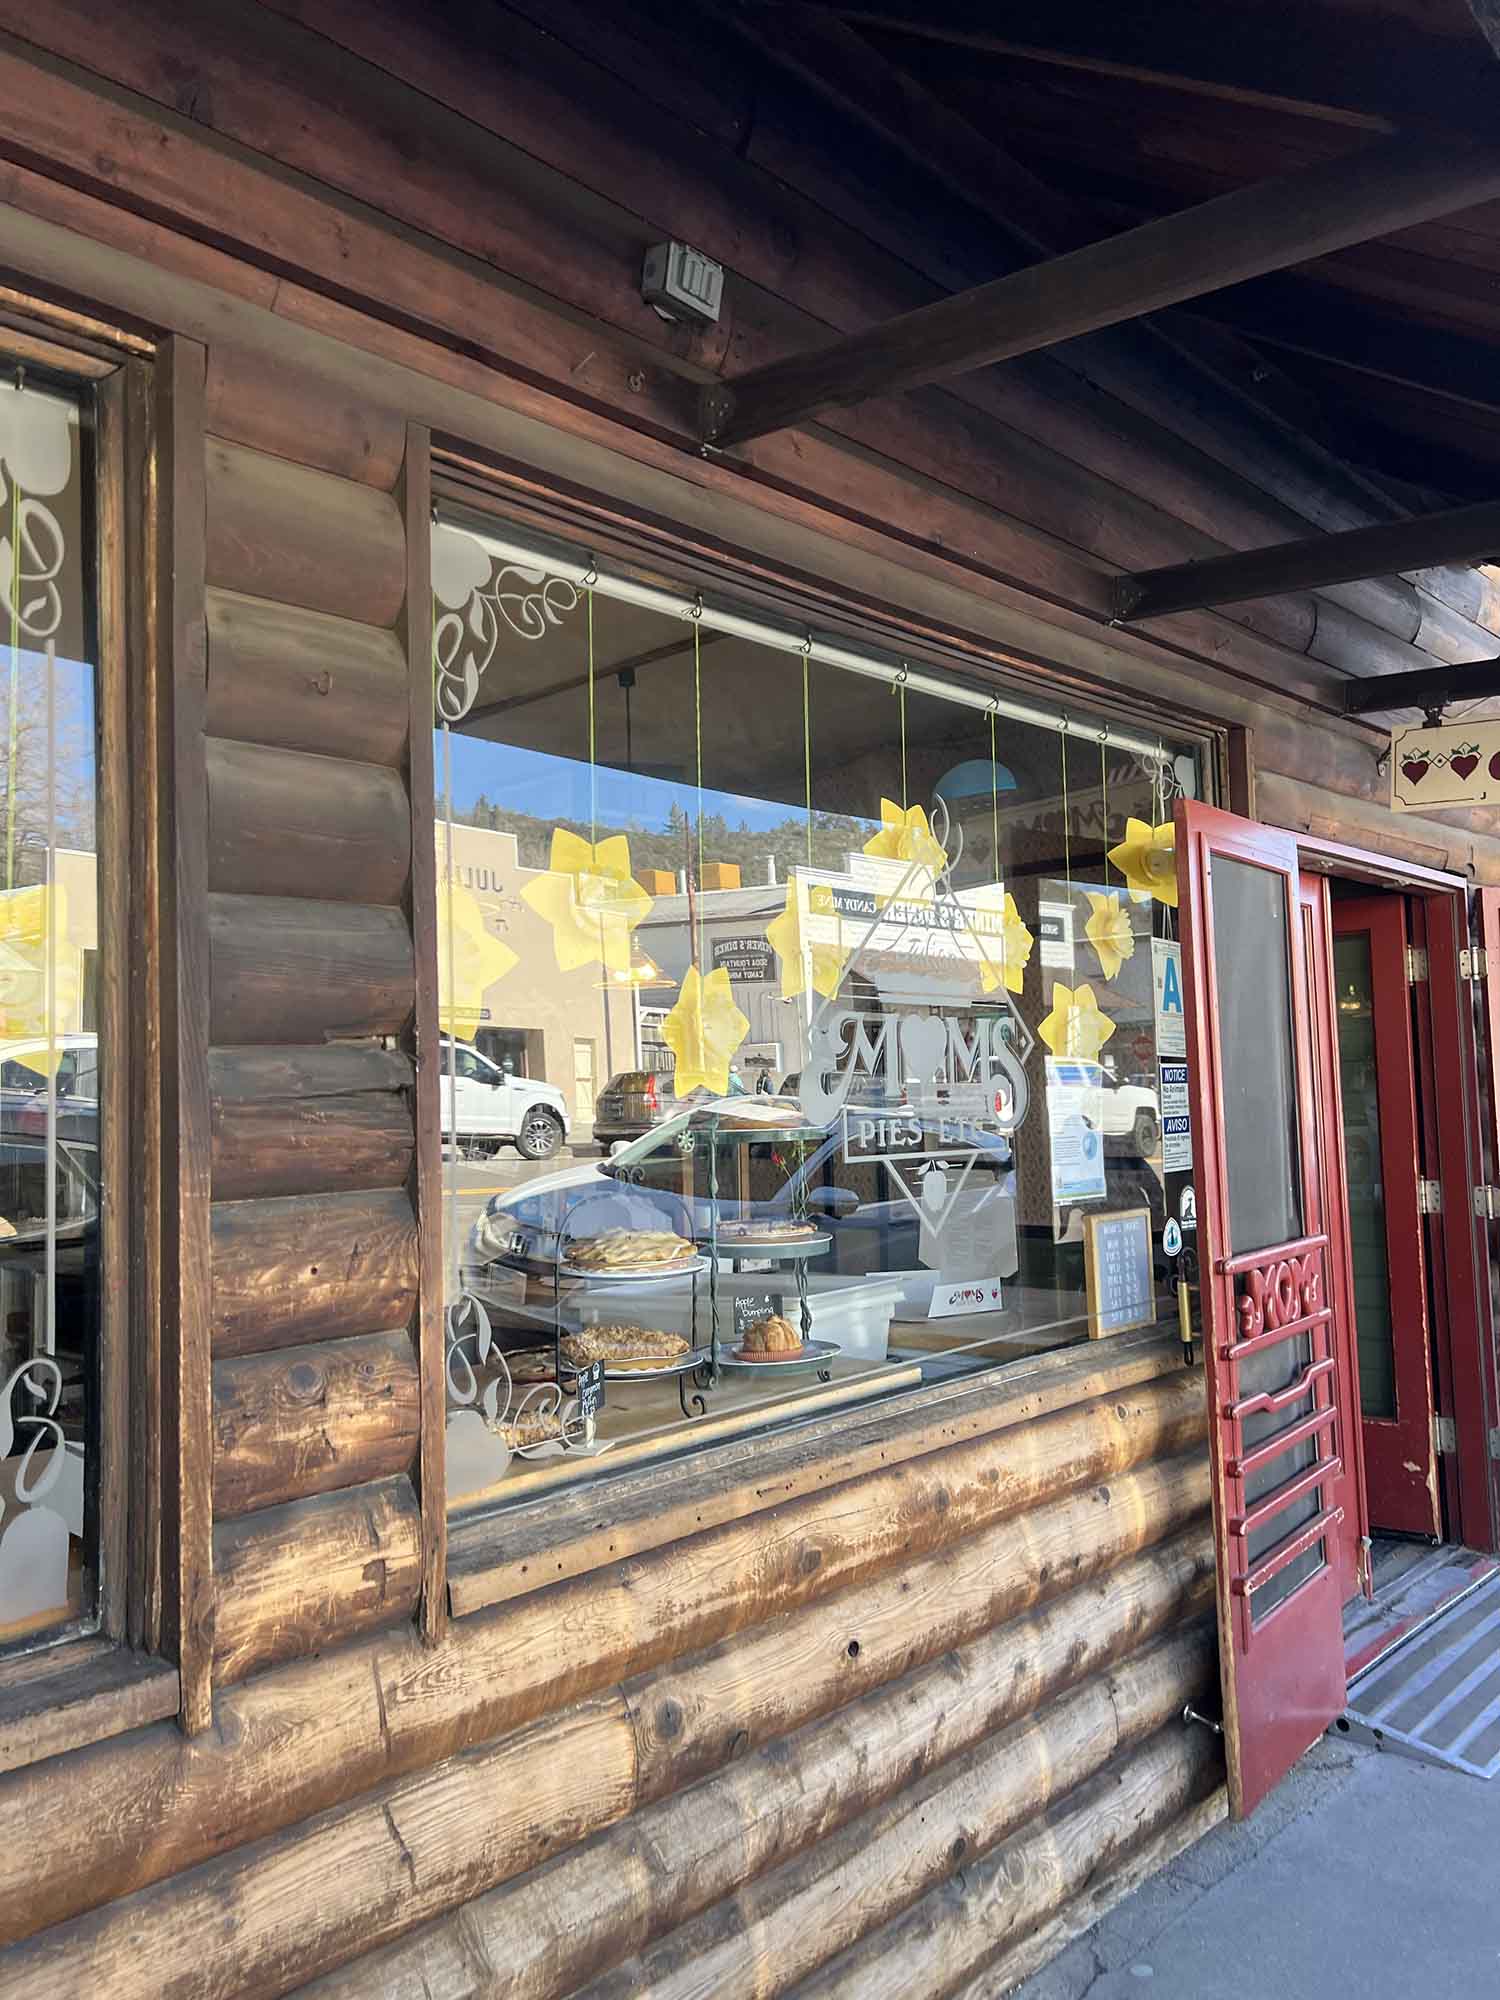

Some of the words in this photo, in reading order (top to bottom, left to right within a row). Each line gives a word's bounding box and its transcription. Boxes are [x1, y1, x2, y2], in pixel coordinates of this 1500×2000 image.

[1163, 957, 1182, 1012] A
[1164, 1069, 1186, 1082] NOTICE
[858, 1118, 923, 1149] PIES
[1166, 1118, 1188, 1132] AVISO
